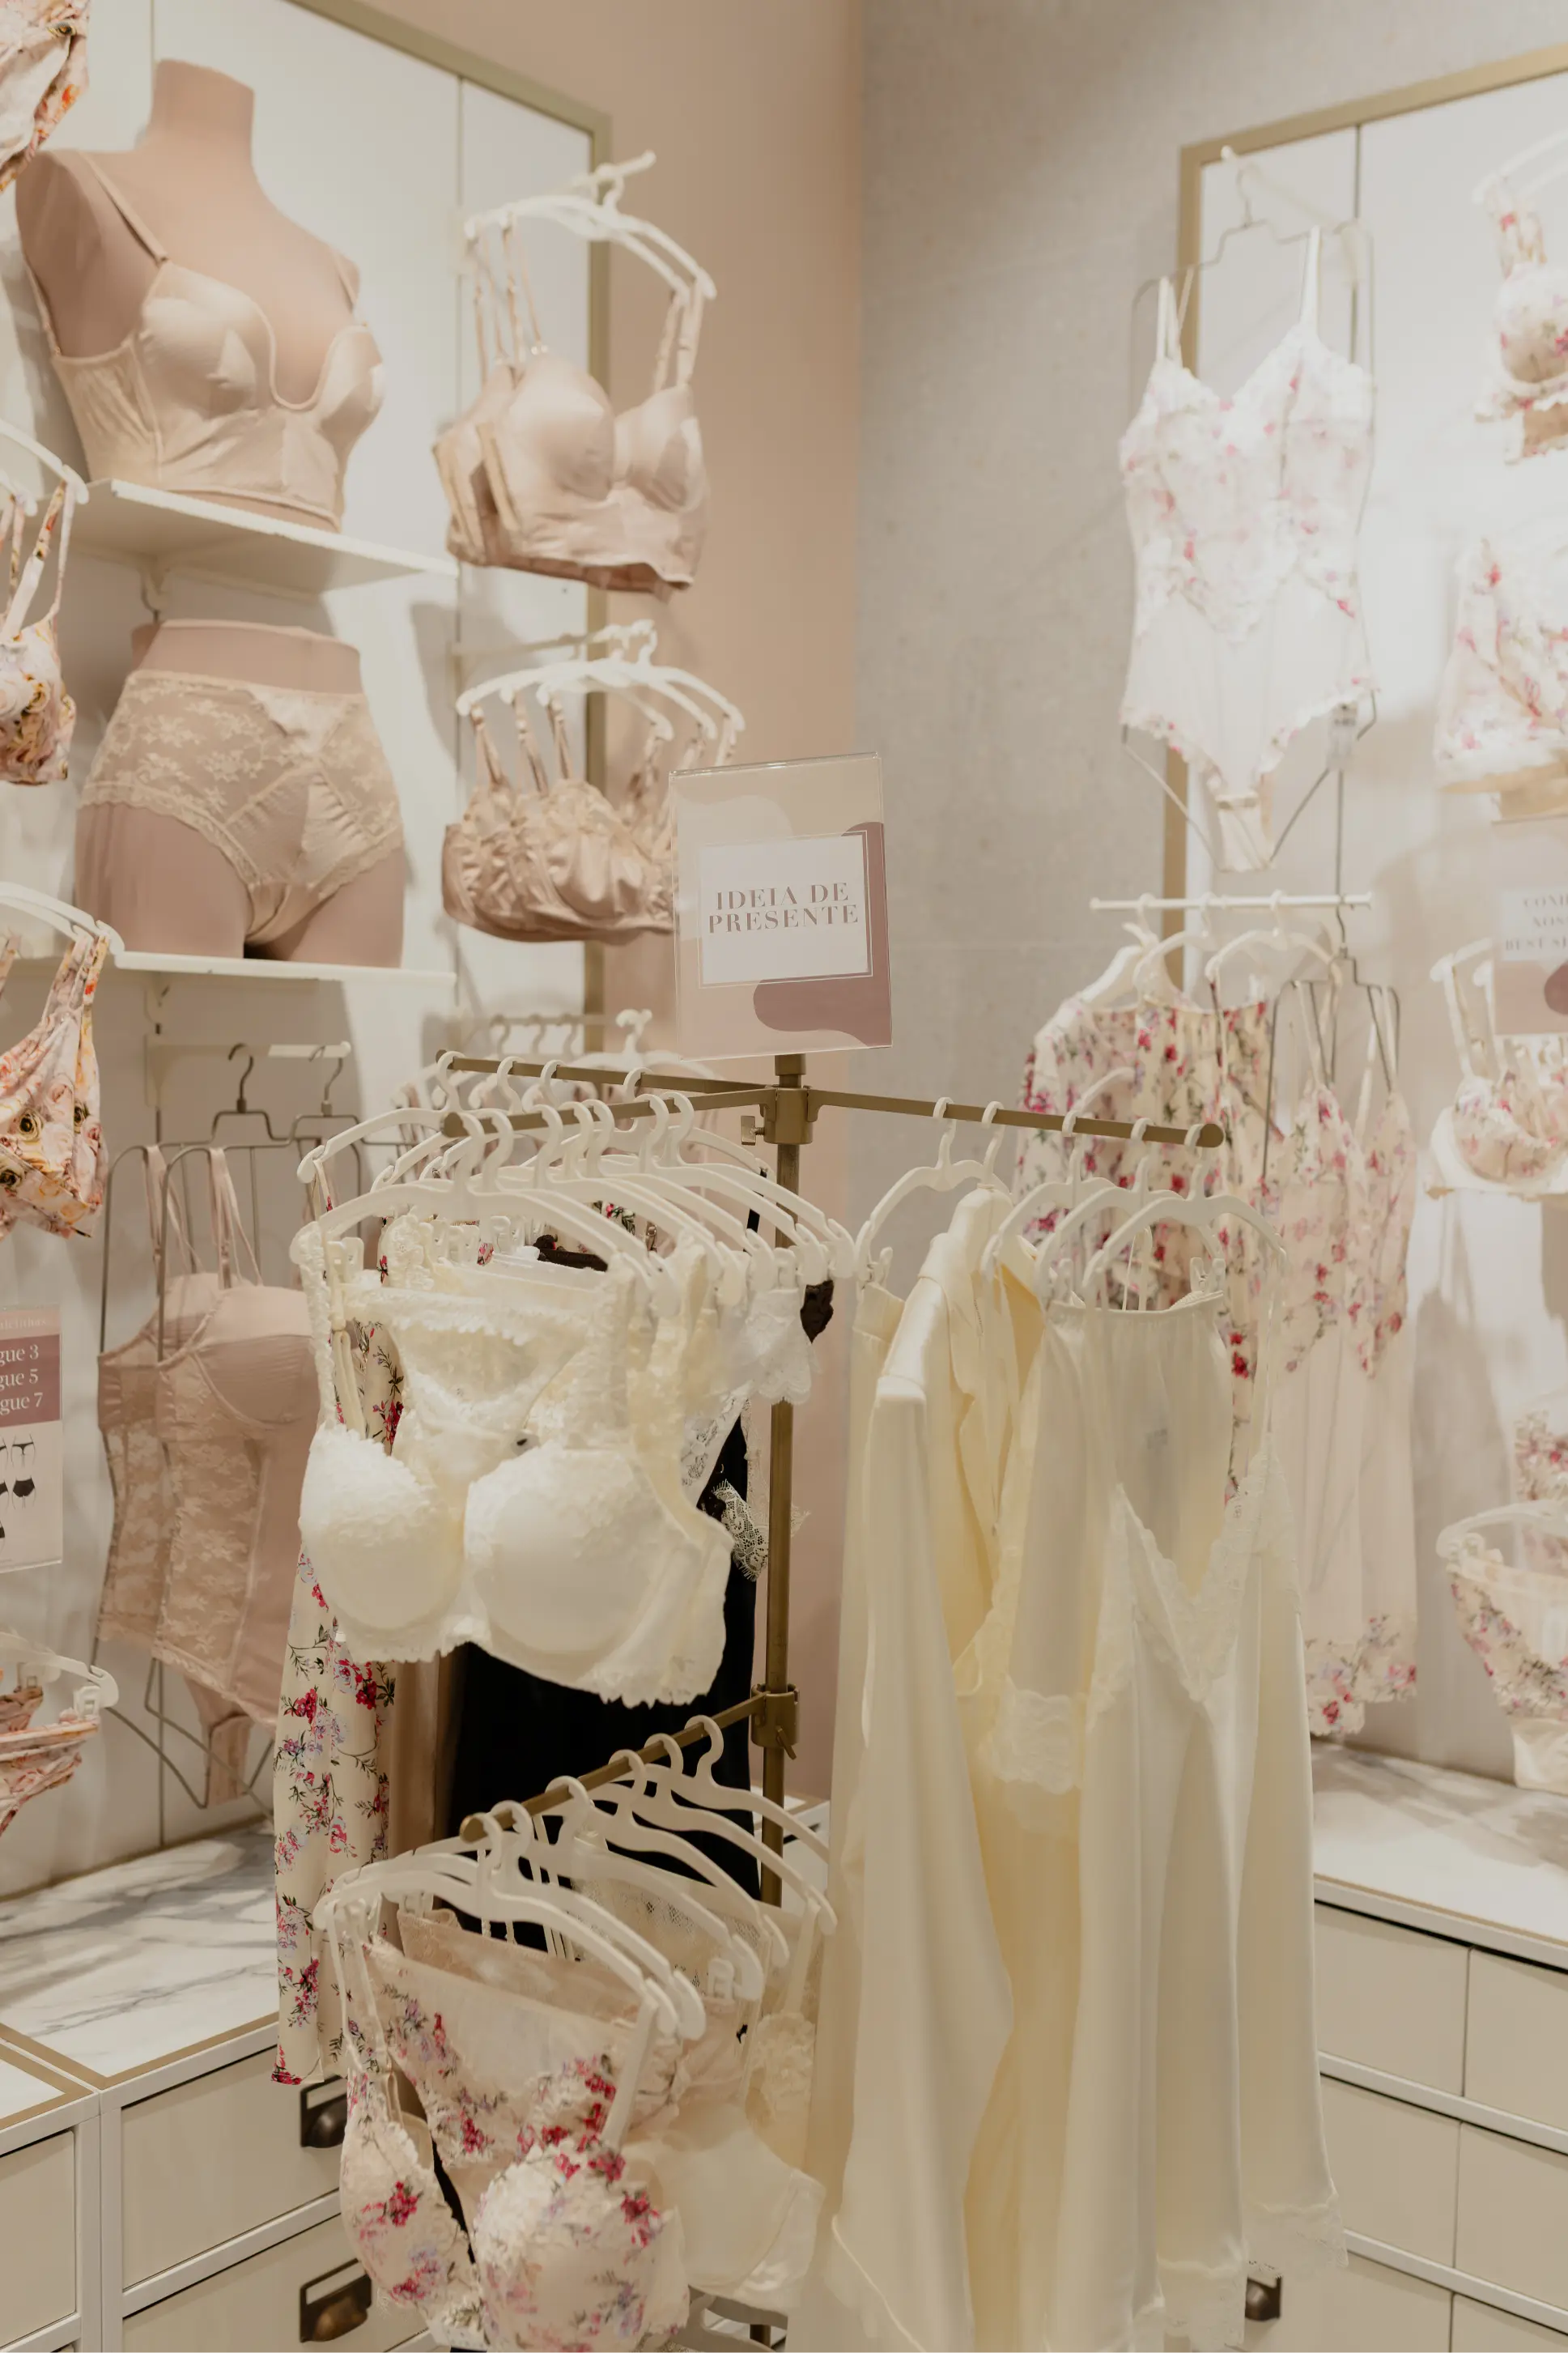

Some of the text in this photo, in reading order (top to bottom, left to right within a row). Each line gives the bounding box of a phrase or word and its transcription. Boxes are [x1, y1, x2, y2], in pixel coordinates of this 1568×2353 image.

[716, 882, 848, 910] IDEIA DE
[708, 904, 858, 934] PRESENTE
[29, 1343, 40, 1360] 3
[28, 1368, 39, 1385] 5
[33, 1391, 44, 1408] 7
